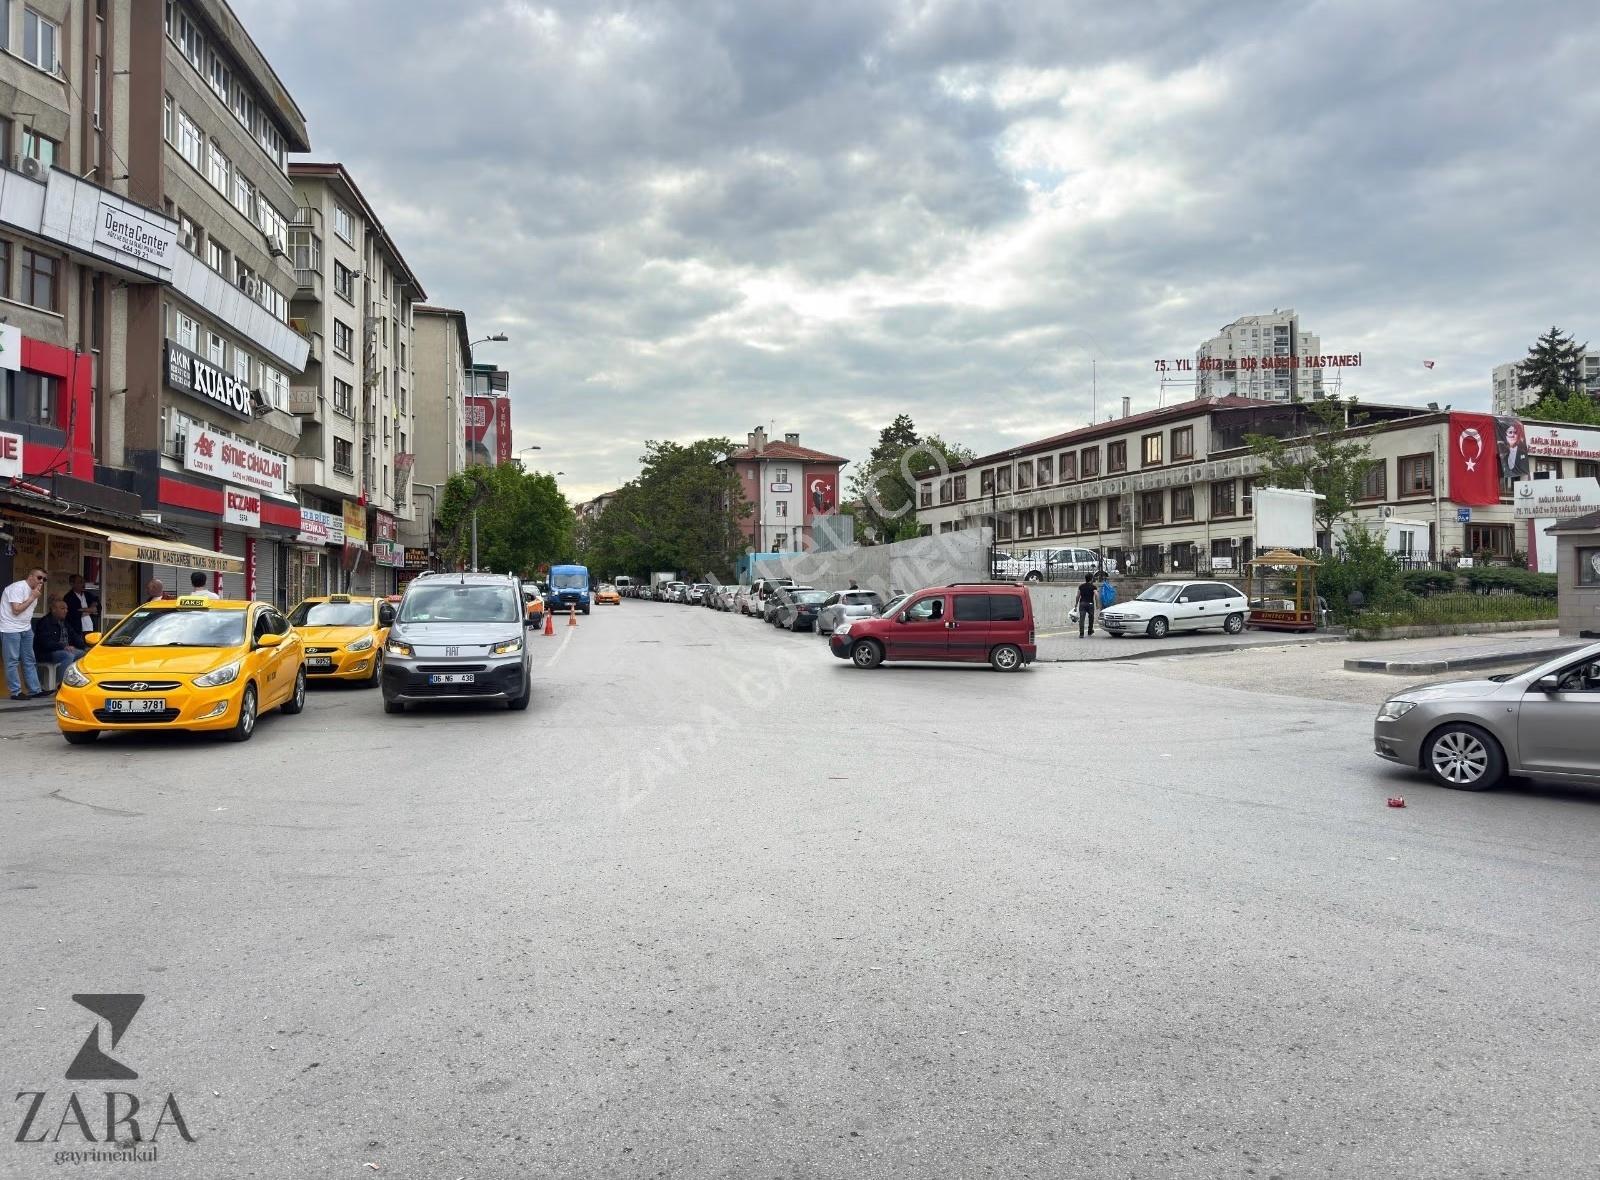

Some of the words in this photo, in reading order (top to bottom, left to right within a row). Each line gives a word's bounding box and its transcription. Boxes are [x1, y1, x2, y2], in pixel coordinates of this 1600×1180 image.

[105, 213, 168, 252] DentaCenter
[122, 244, 133, 253] 444
[142, 251, 149, 259] 21
[170, 349, 191, 372] AKIN
[1154, 359, 1170, 372] 75.
[1175, 359, 1192, 370] YIL
[1305, 351, 1362, 369] HASTANESİ
[193, 359, 252, 417] KUAFÖR
[247, 451, 282, 480] CİHAZLARI
[227, 491, 260, 514] ECZANE
[300, 520, 326, 535] MEDİKAL
[136, 547, 161, 562] ANKARA
[445, 646, 460, 657] FIAT
[433, 675, 442, 683] 06
[112, 700, 122, 709] 06
[128, 700, 133, 710] T
[143, 700, 163, 709] 3781
